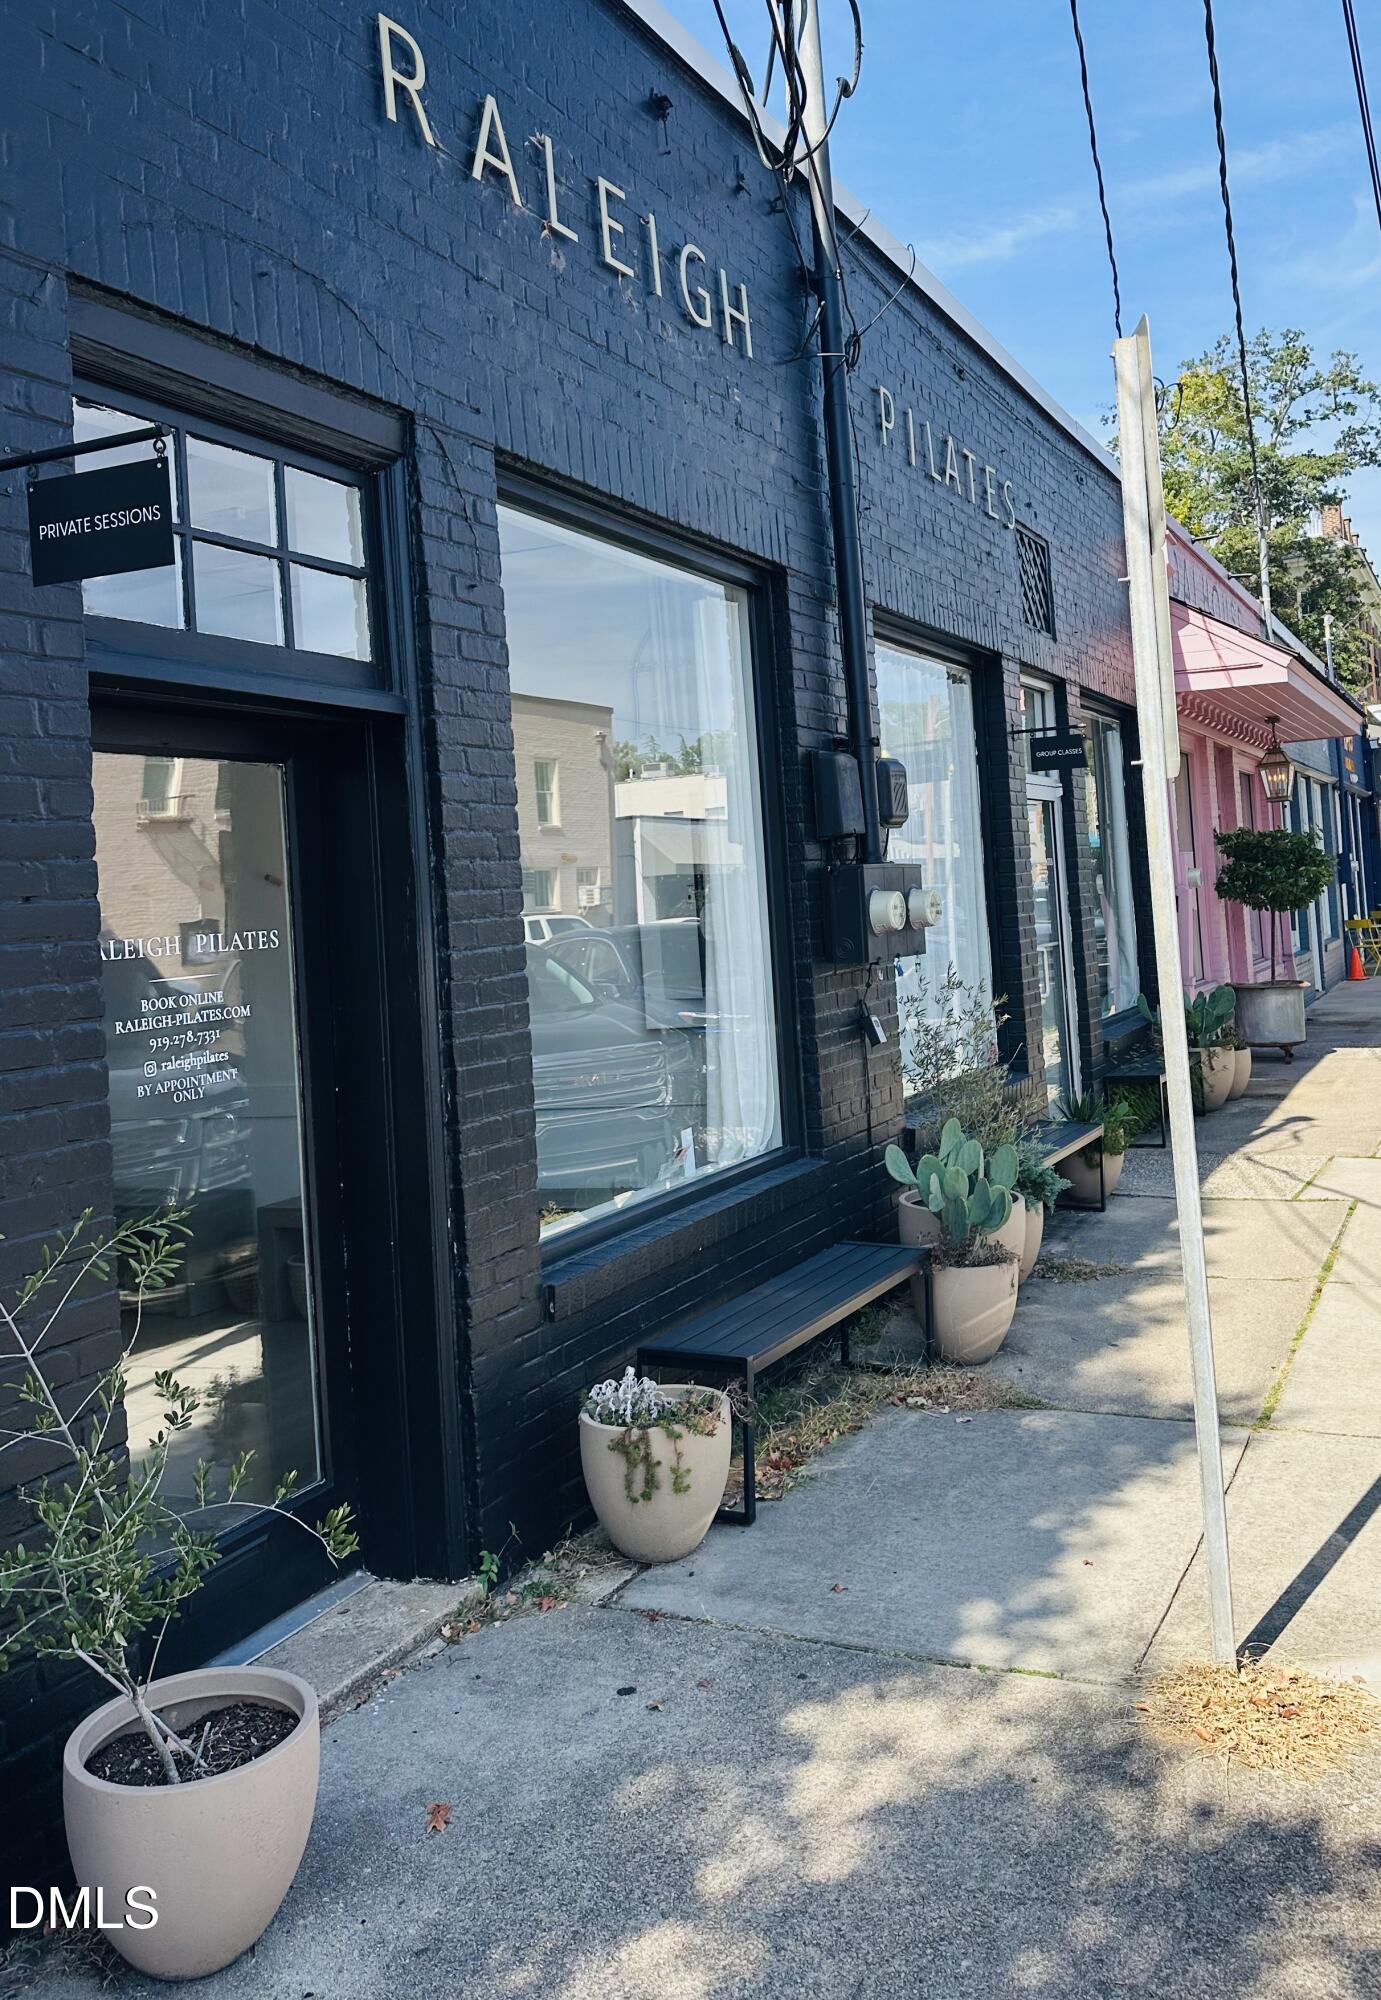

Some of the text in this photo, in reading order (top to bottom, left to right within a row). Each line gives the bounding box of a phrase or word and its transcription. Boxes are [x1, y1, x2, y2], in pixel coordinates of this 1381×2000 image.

[378, 12, 1015, 530] RALEIGH PILATES
[39, 505, 161, 541] PRIVATE SESSIONS
[1036, 747, 1083, 758] GROUP CLASSES
[100, 929, 280, 961] LEIGH PILATES
[140, 990, 224, 1013] BOOK ONLINE
[114, 1004, 252, 1035] RALEIGH-PILATES.COM
[149, 1029, 221, 1053] 919.278.7331
[160, 1050, 230, 1072] raleighpilates
[136, 1068, 239, 1098] BY APPOINTMENT
[173, 1087, 205, 1103] ONLY
